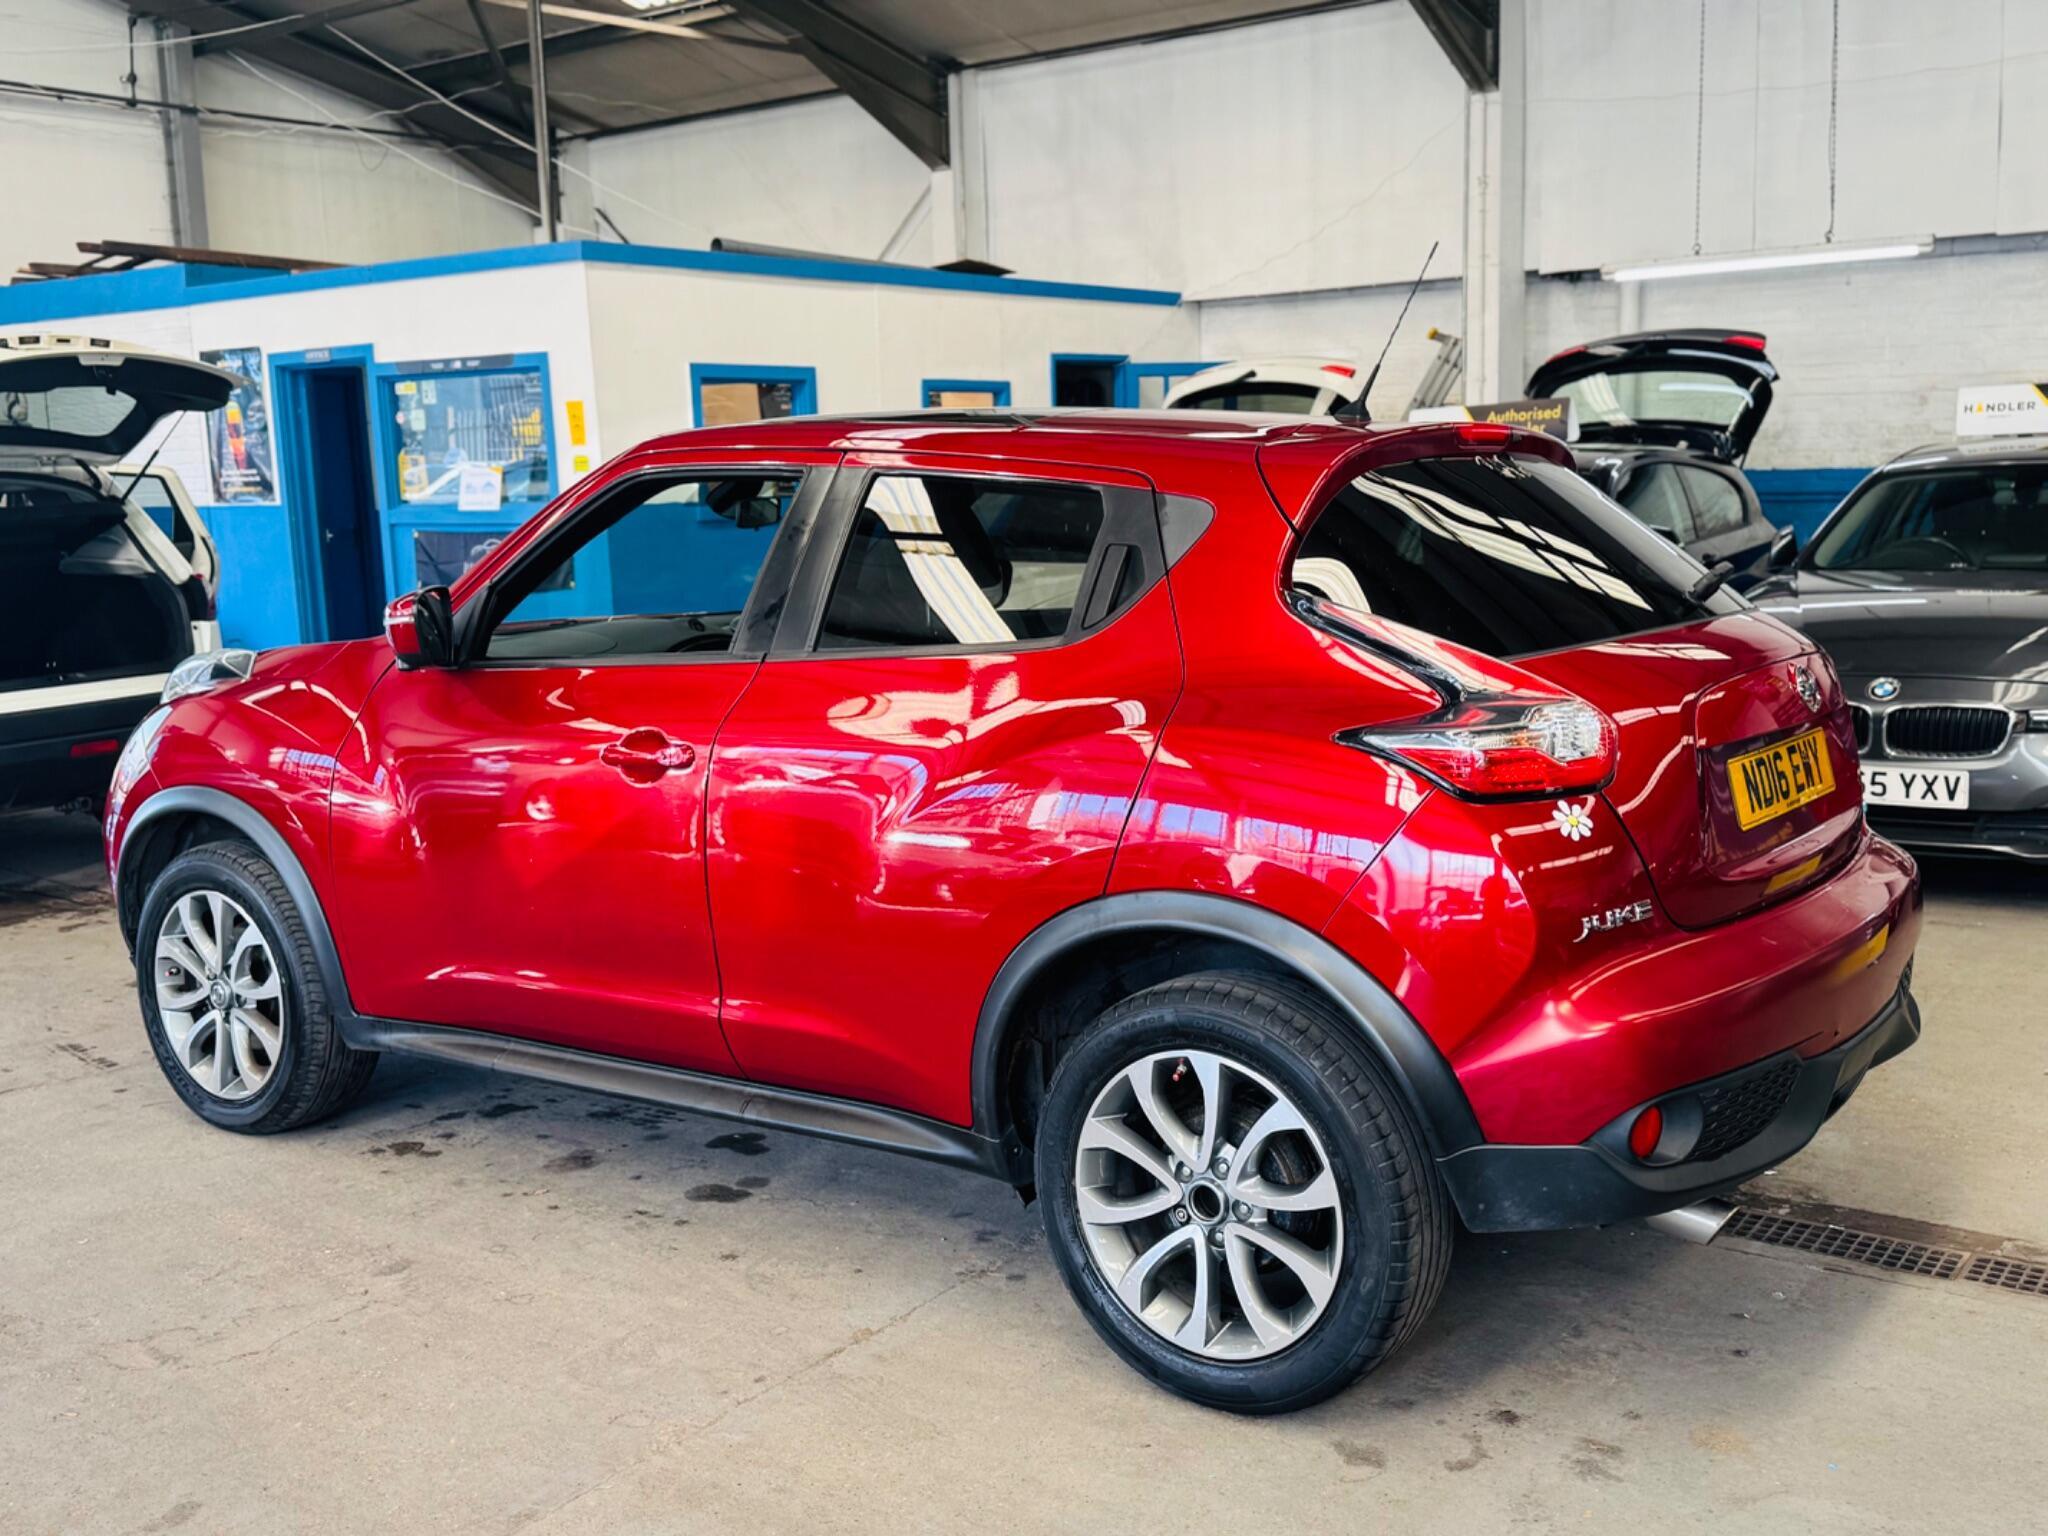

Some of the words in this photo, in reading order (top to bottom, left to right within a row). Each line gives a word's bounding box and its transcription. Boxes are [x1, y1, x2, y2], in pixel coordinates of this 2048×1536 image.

[1486, 403, 1562, 424] Authorised
[1741, 750, 1790, 814] ND16
[1899, 772, 1961, 801] YXV
[1573, 899, 1653, 943] JUKE
